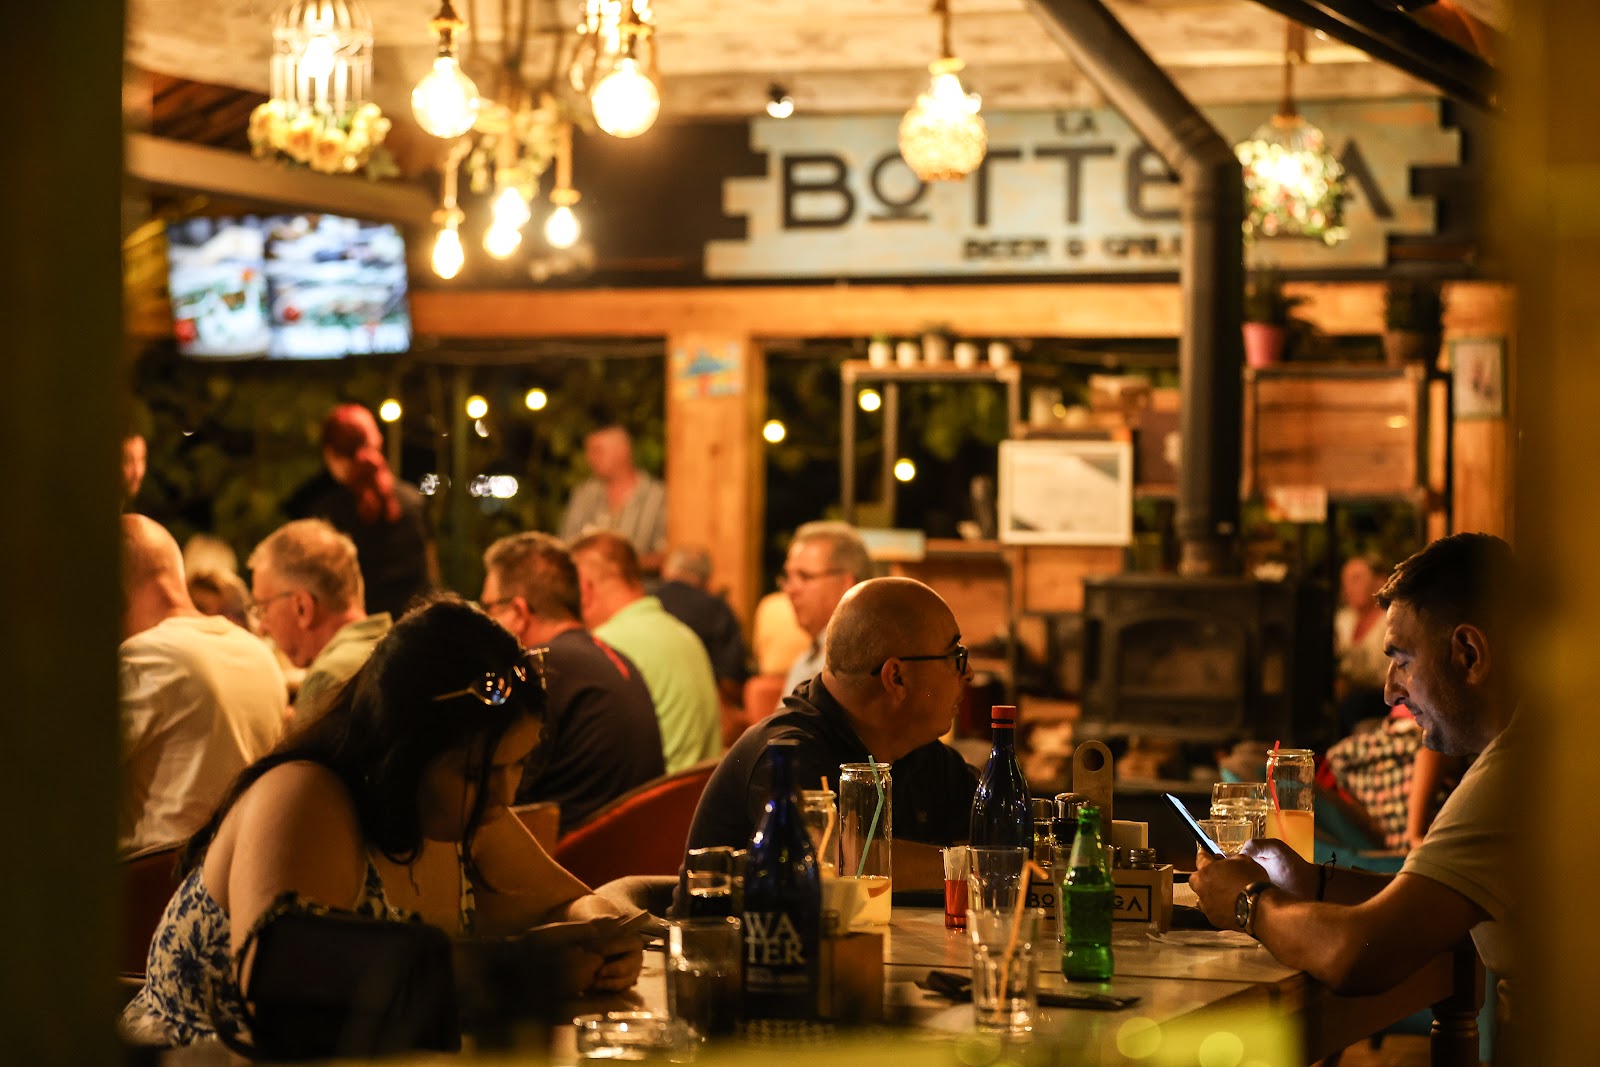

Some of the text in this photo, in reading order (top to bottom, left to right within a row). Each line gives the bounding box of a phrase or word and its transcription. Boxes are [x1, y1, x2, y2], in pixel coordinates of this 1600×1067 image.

[1055, 109, 1097, 133] LA
[783, 139, 1394, 229] BOTTEA
[1029, 893, 1143, 911] BOGA
[743, 911, 800, 942] WA
[744, 936, 807, 965] TER
